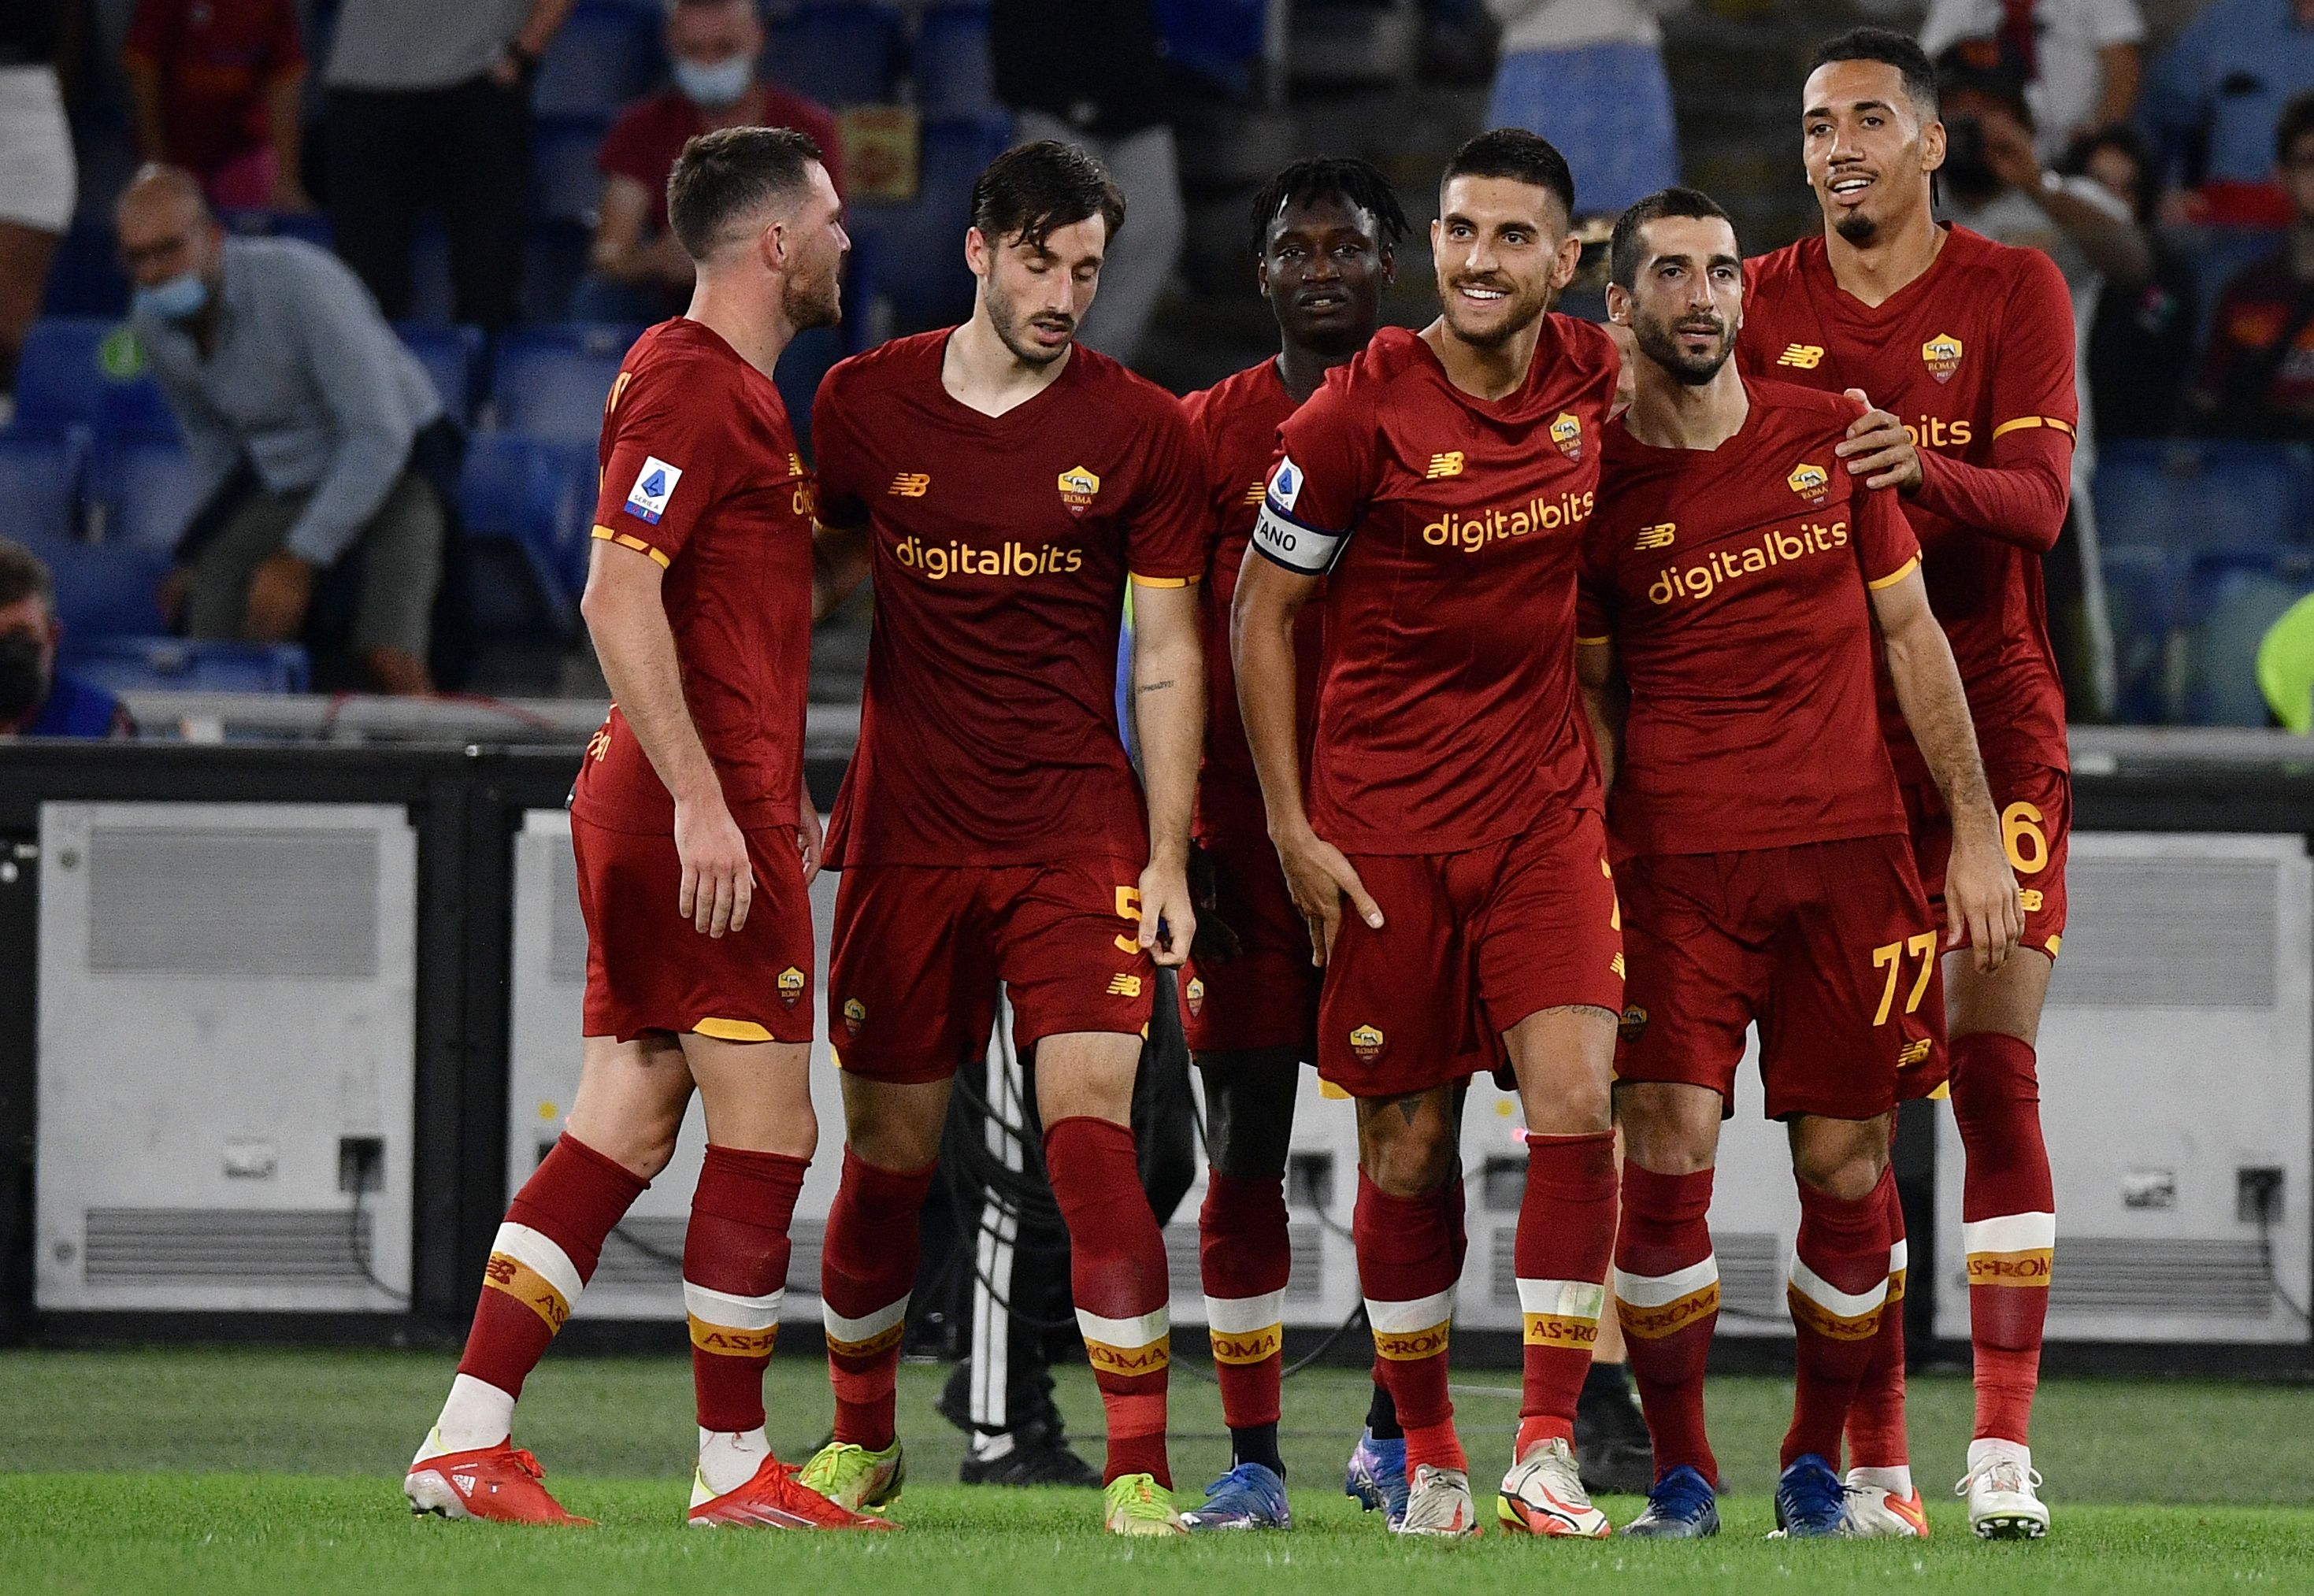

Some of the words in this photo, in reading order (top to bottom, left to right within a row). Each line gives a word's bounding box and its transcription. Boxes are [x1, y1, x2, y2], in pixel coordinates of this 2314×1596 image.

[1928, 361, 1956, 371] ROMA
[634, 494, 653, 507] SERIE
[1063, 494, 1092, 505] ROMA
[1801, 486, 1828, 499] ROMA
[1423, 491, 1593, 553] digitalbits
[896, 535, 1082, 580] digitalbits
[1648, 521, 1848, 605] digitalbits
[2001, 801, 2048, 874] 6
[1114, 886, 1143, 955] 5
[1872, 929, 1938, 1027] 77
